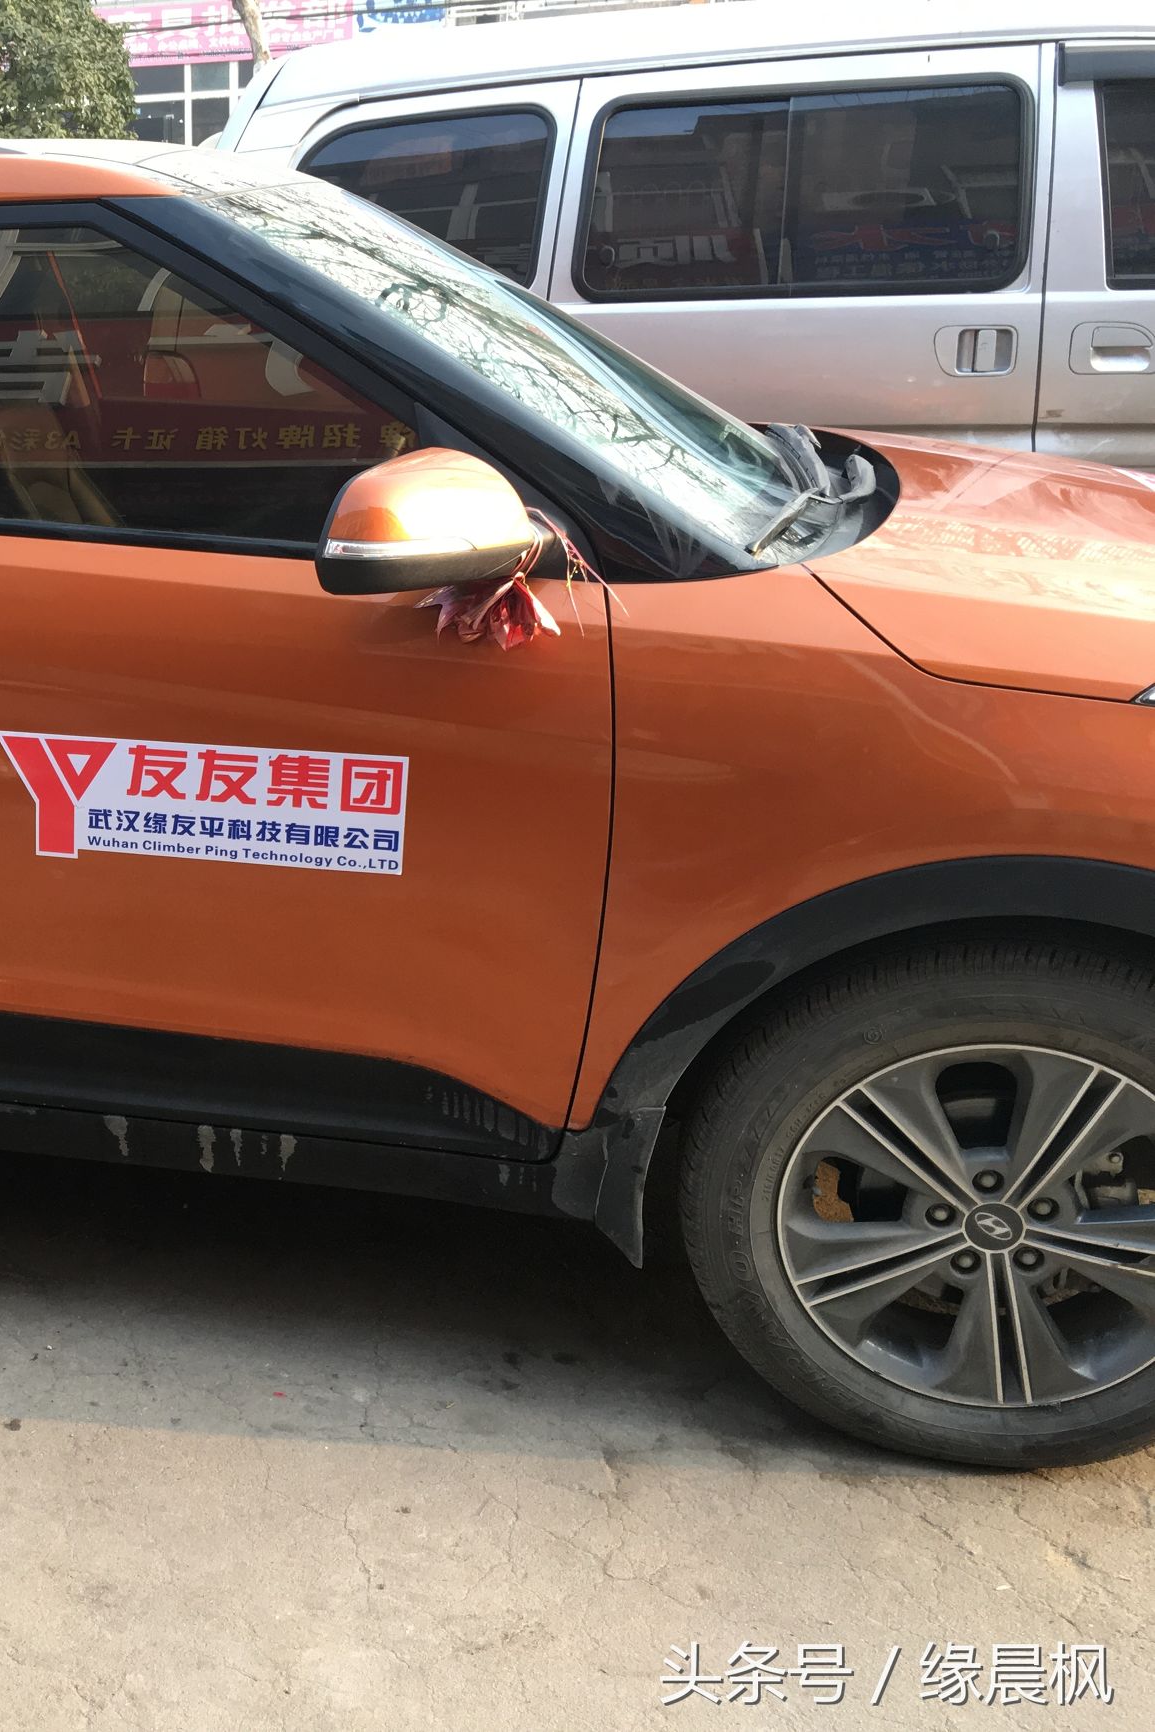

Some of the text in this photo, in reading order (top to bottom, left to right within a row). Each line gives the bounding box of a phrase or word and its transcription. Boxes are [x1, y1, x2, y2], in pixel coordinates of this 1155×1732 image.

[126, 745, 404, 815] 友友集团
[88, 808, 400, 852] 武汉缘友平科技有限公司
[87, 835, 400, 872] Wuhan Climber Ping Technology Co.,LTD
